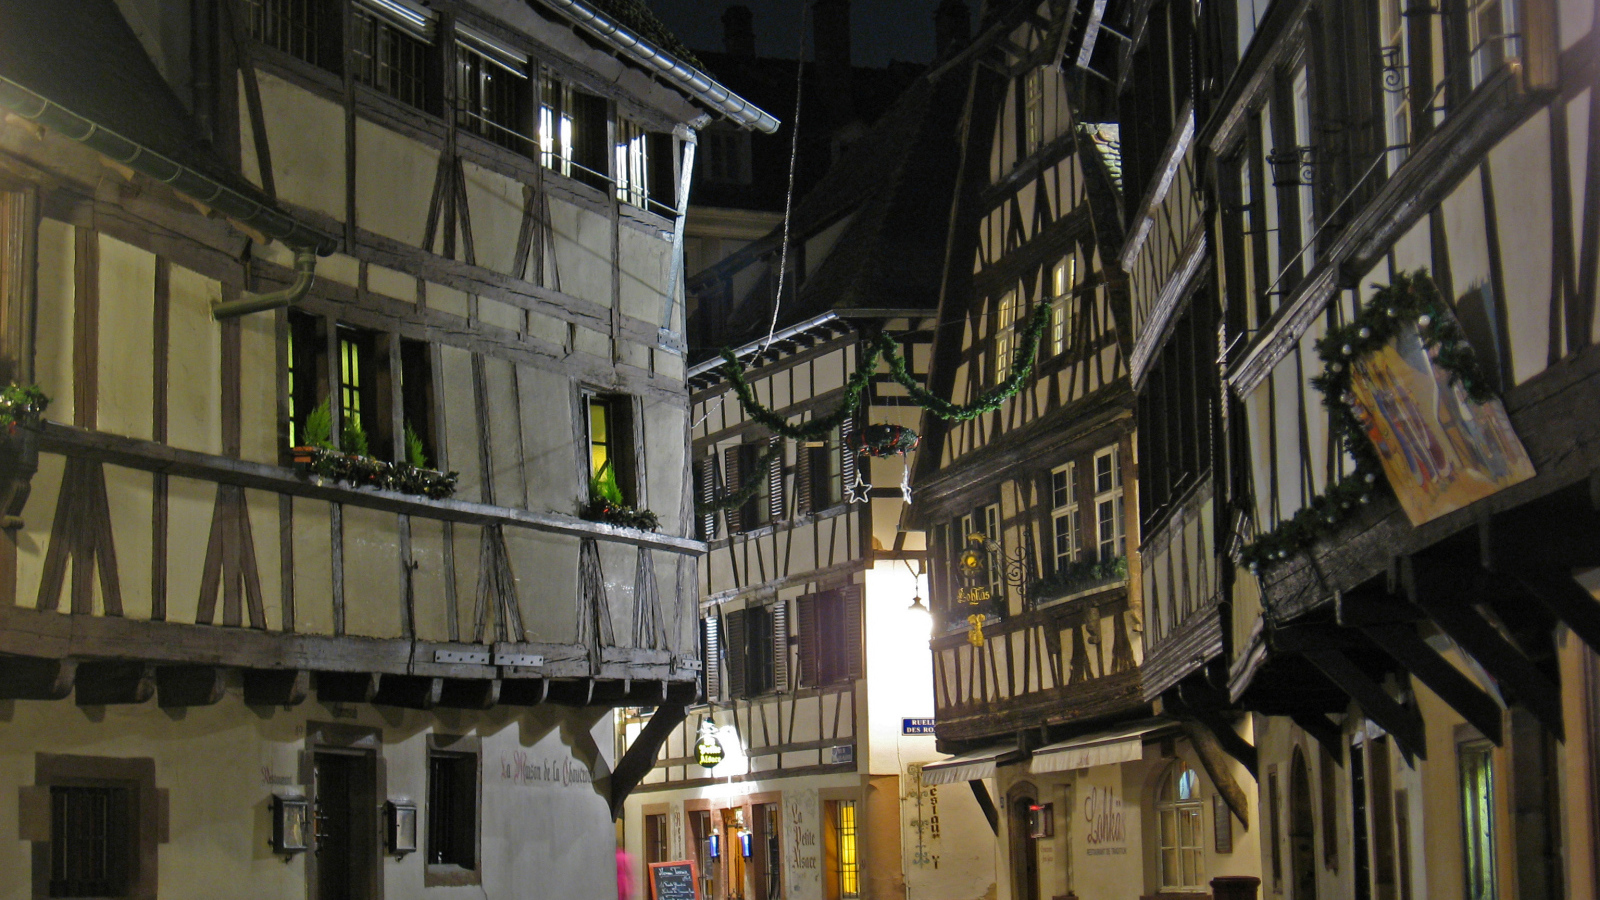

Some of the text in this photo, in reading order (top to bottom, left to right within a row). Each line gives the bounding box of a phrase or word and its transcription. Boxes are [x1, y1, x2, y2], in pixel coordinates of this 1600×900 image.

[501, 750, 510, 781] La
[513, 751, 541, 785] Maison
[543, 758, 550, 781] de
[791, 803, 802, 824] La
[793, 826, 815, 849] Petite
[792, 847, 816, 869] Alsace
